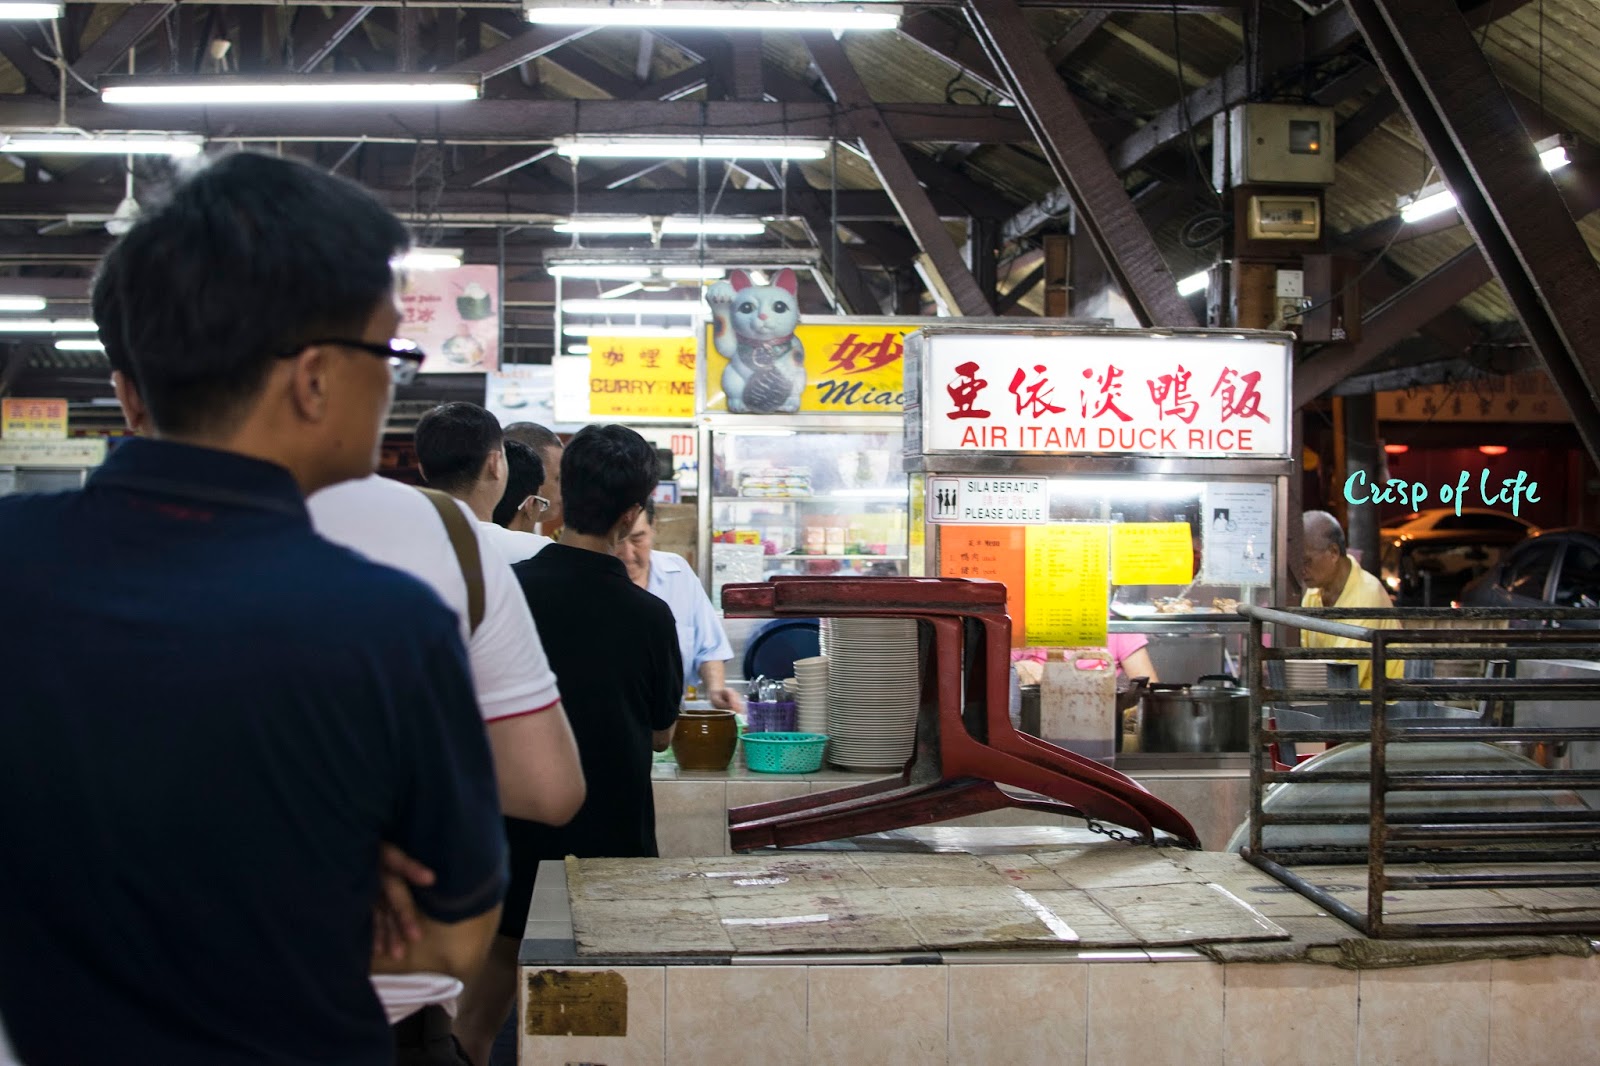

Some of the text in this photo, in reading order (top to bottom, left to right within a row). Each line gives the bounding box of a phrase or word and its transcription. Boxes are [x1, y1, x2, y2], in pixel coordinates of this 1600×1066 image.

[590, 379, 656, 394] CURRY
[961, 426, 1253, 450] AIR ITAM DUCK RICE
[967, 481, 1039, 493] SILA BERATUR
[965, 508, 1041, 520] PLEASE QUEUE
